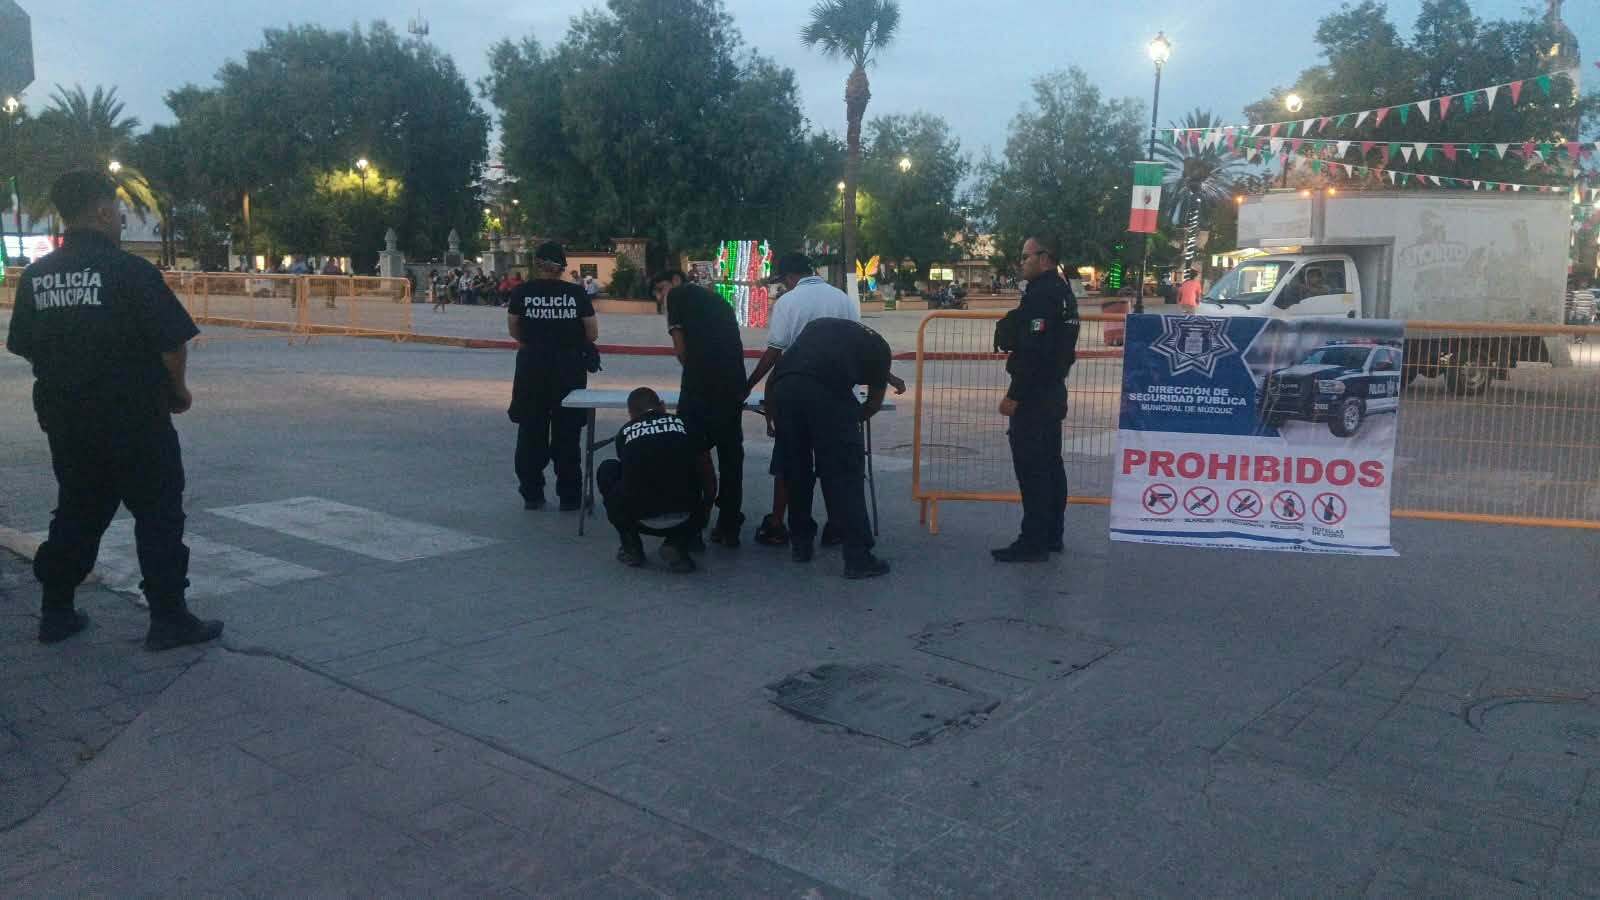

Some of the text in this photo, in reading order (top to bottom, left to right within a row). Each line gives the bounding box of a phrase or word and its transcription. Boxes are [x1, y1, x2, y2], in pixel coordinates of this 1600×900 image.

[31, 267, 103, 292] POLICÍA
[33, 287, 103, 311] MUNICIPAL
[524, 293, 577, 307] POLICÍA
[524, 307, 577, 319] AUXILIAR
[1128, 392, 1194, 404] SEGURIDAD
[1213, 387, 1230, 397] DE
[1140, 403, 1182, 412] MUNICIPAL
[1184, 405, 1197, 413] DE
[624, 423, 688, 445] AUXILIAR
[1122, 448, 1385, 488] PROHIBIDOS
